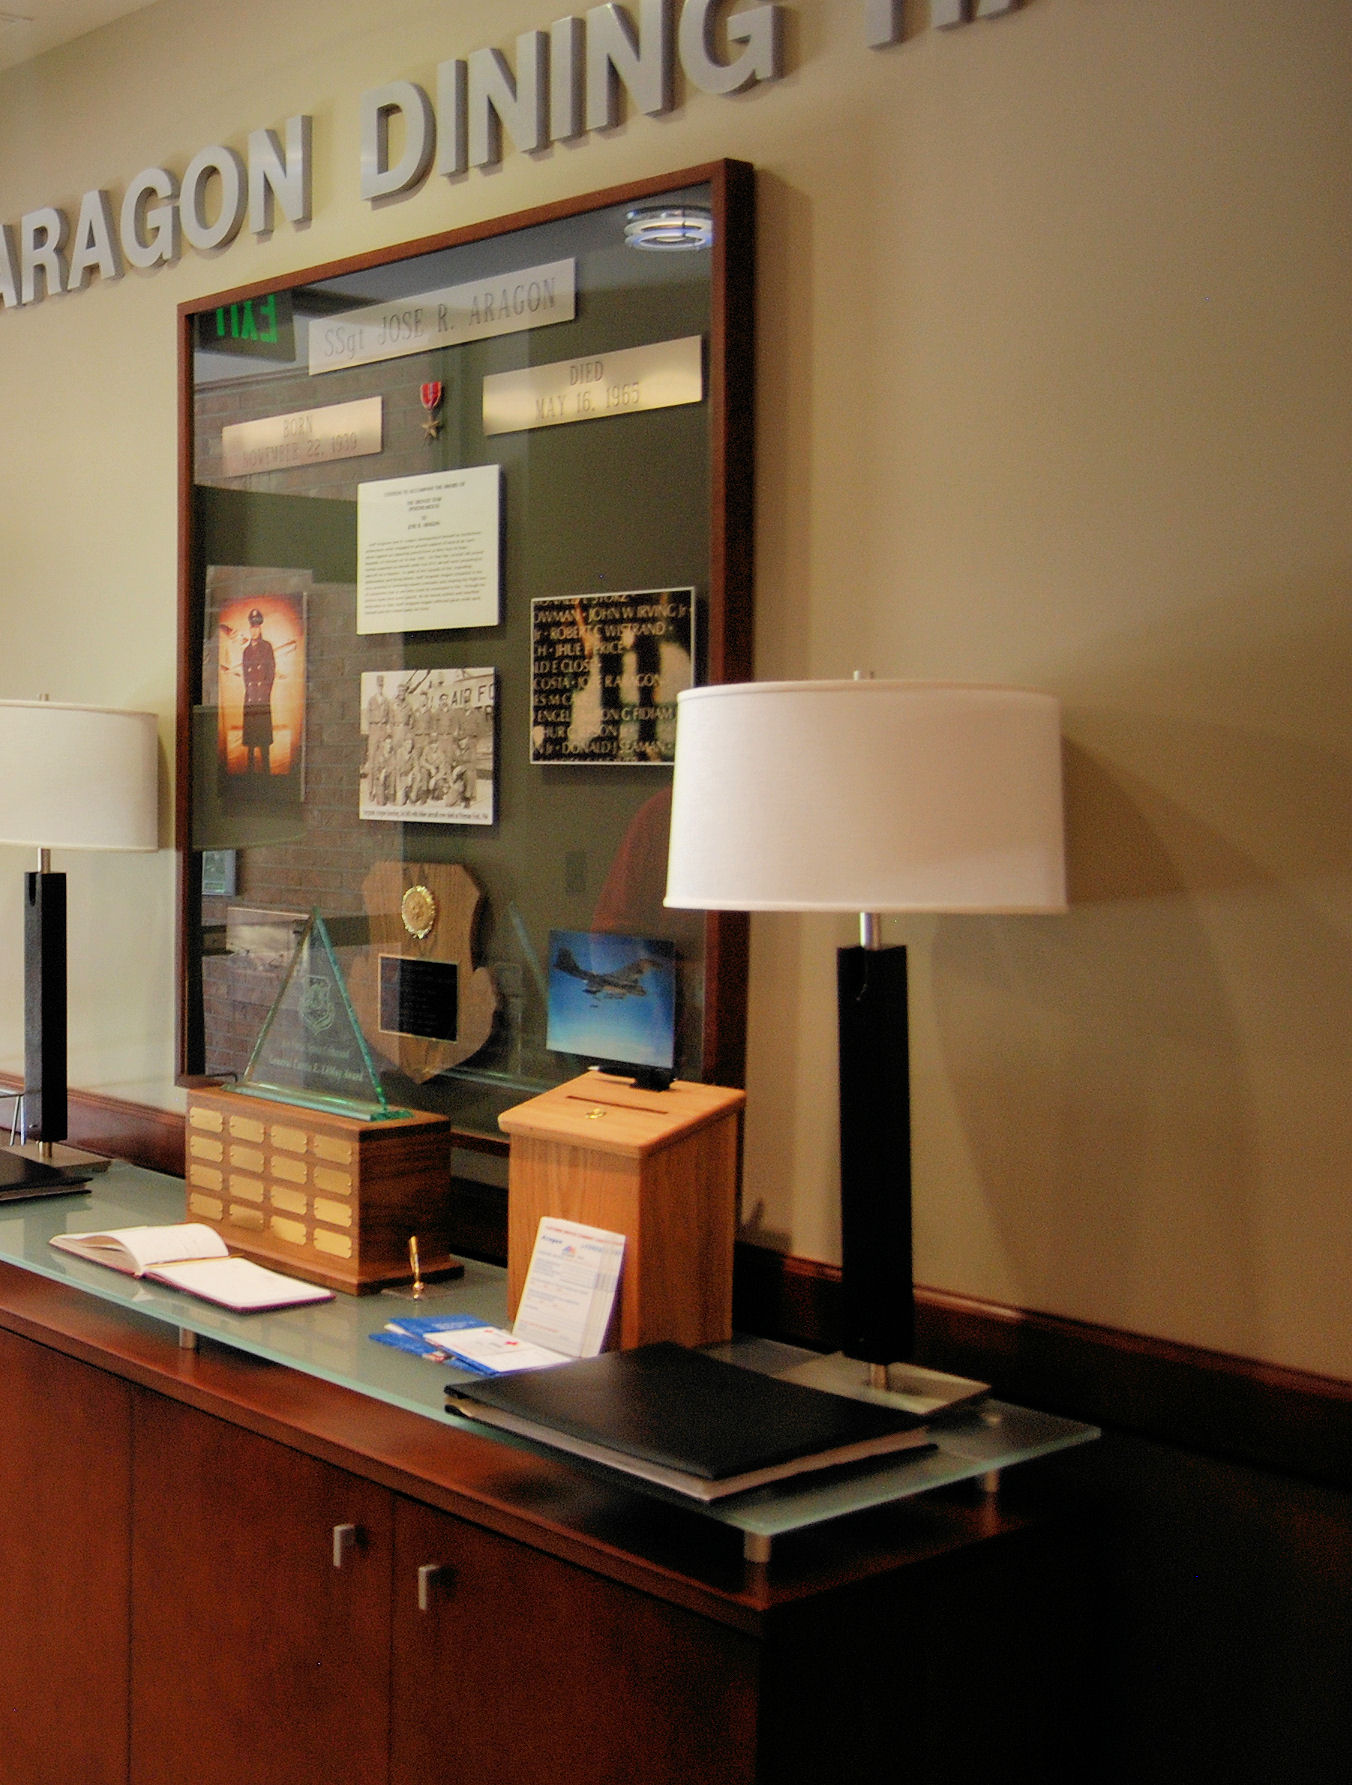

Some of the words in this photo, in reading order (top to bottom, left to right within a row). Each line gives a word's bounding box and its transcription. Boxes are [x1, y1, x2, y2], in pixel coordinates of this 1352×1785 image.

[360, 0, 785, 200] DINING
[324, 326, 364, 359] SSgt
[378, 308, 423, 345] JOSE
[437, 303, 454, 332] R.
[468, 277, 556, 325] ARAGON
[569, 361, 603, 386] DIED
[536, 395, 566, 420] MAY
[606, 382, 639, 408] 1965
[283, 415, 313, 438] BORN
